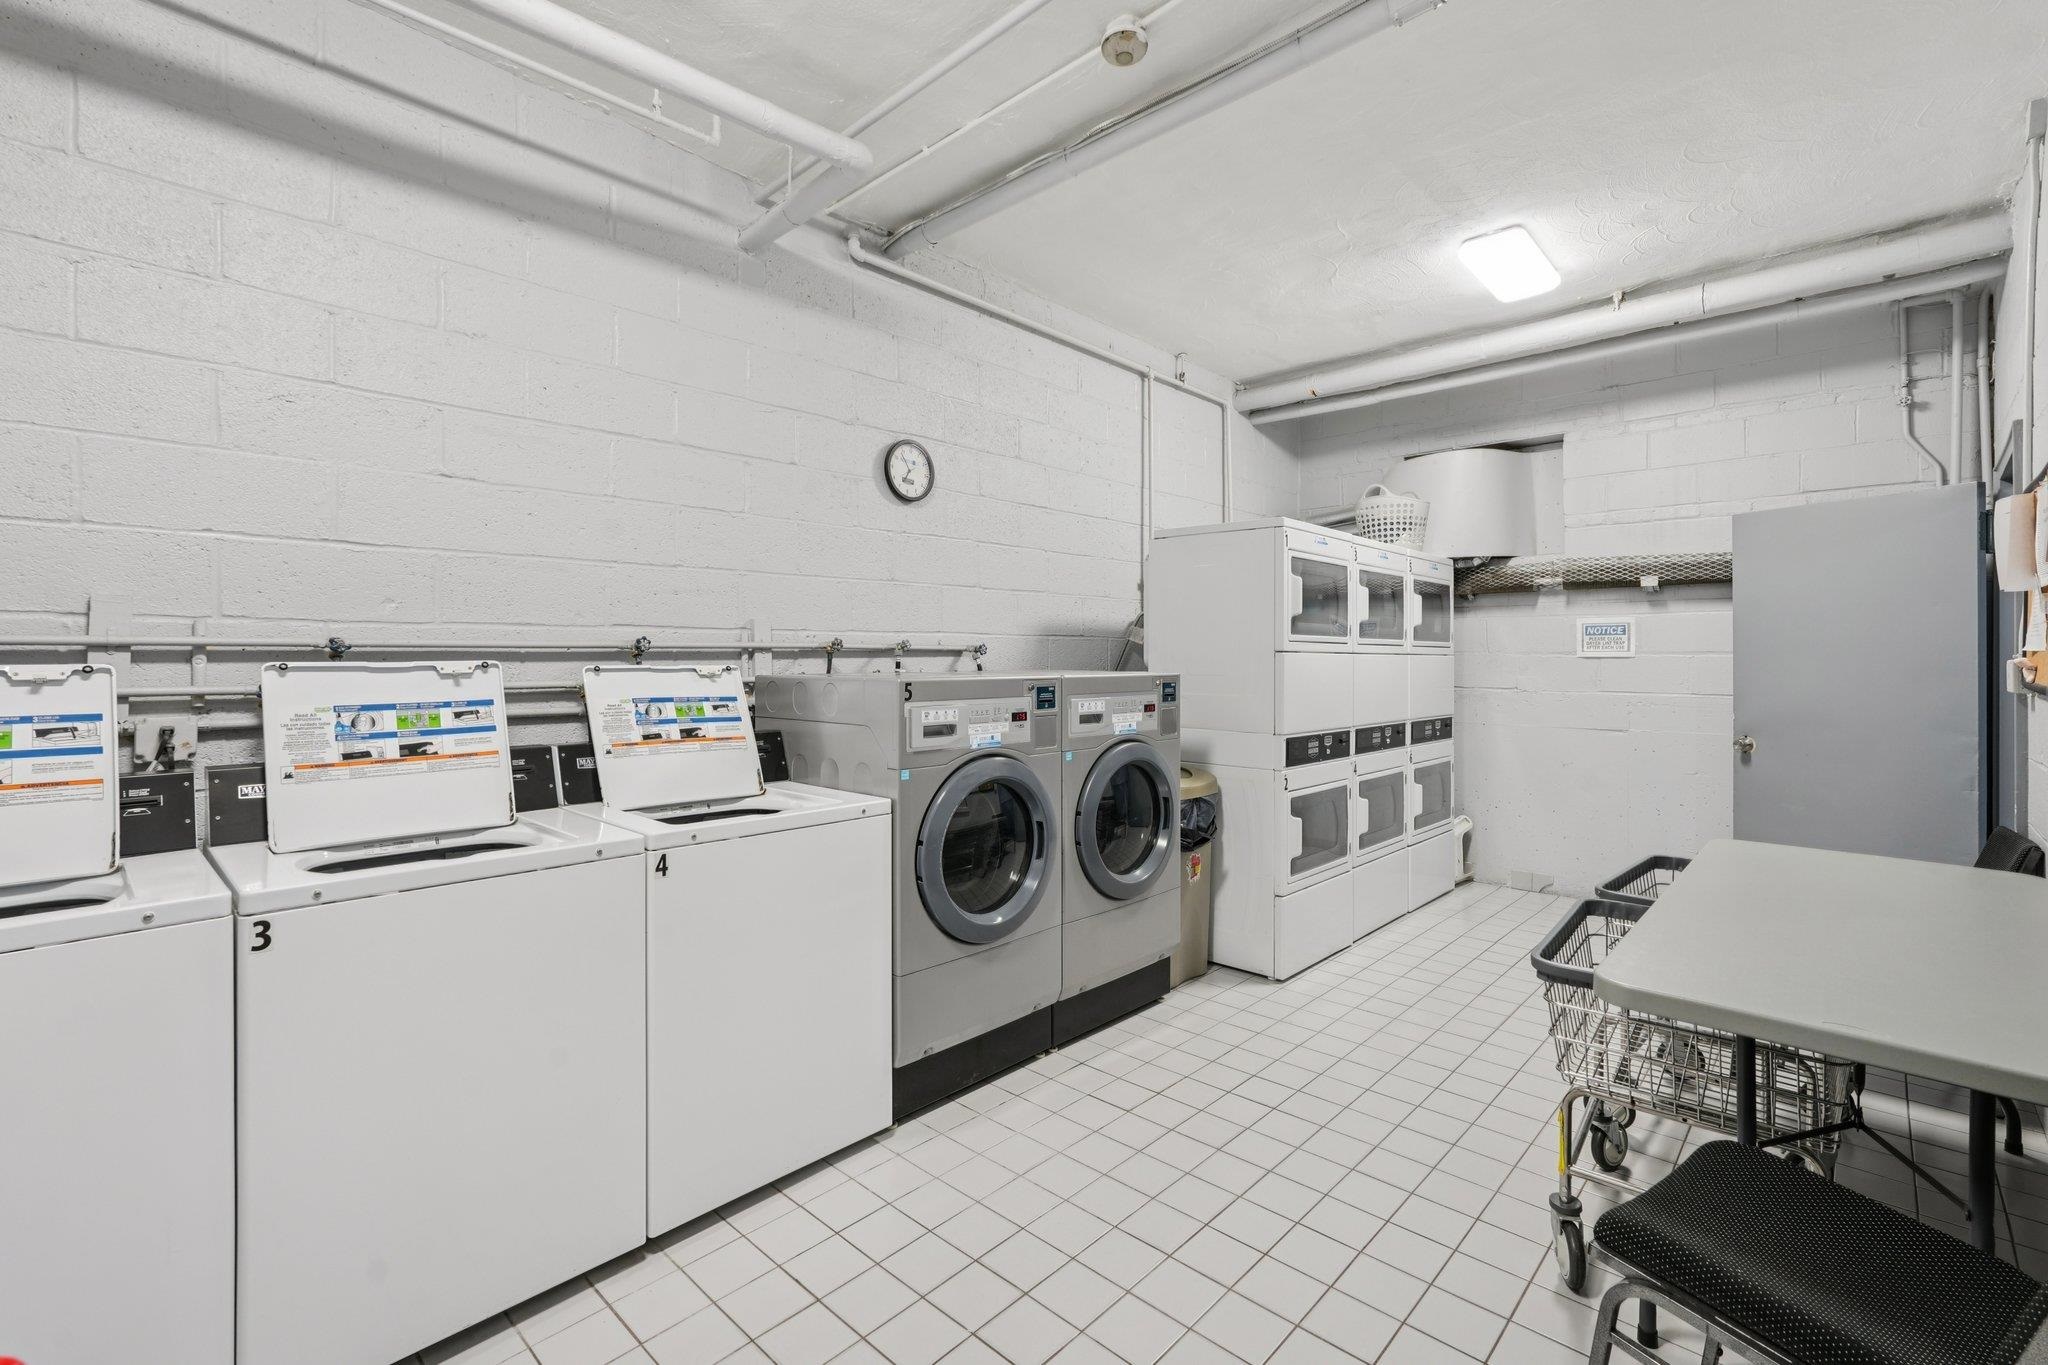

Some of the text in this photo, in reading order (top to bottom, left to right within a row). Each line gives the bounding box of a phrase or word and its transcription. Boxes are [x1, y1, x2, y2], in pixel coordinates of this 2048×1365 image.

[1586, 626, 1625, 635] NOTICE
[904, 682, 912, 701] 5
[655, 853, 669, 877] 4
[251, 920, 272, 952] 3
